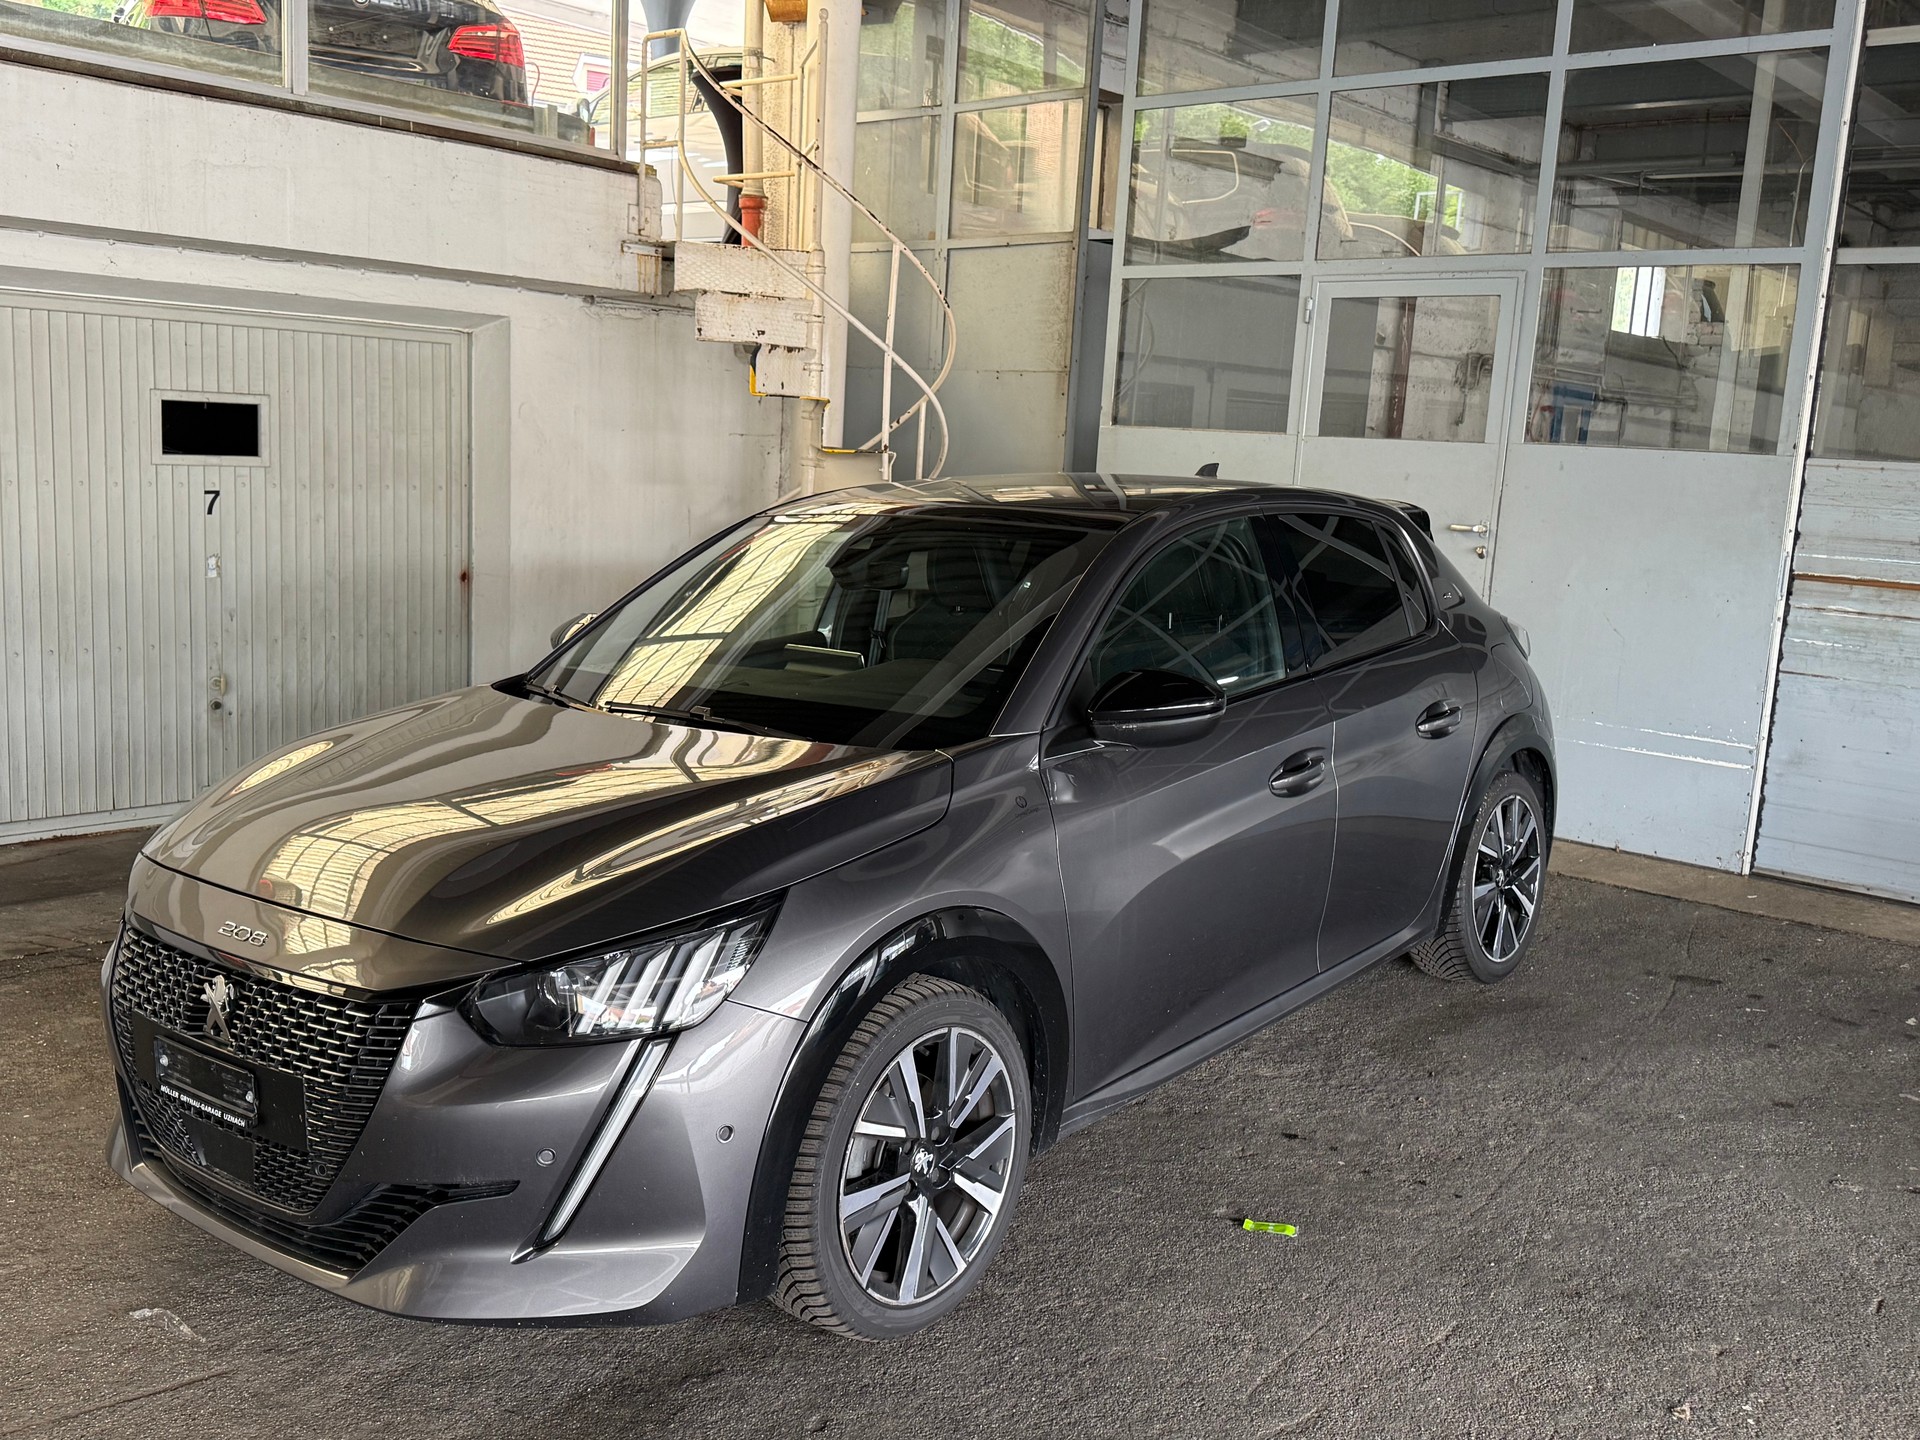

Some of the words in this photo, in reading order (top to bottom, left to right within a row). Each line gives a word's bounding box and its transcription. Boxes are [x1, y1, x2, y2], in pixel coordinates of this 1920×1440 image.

[204, 490, 220, 515] 7
[217, 921, 267, 946] 208
[160, 1084, 179, 1099] MÜLLER
[223, 1113, 246, 1127] UZNACH
